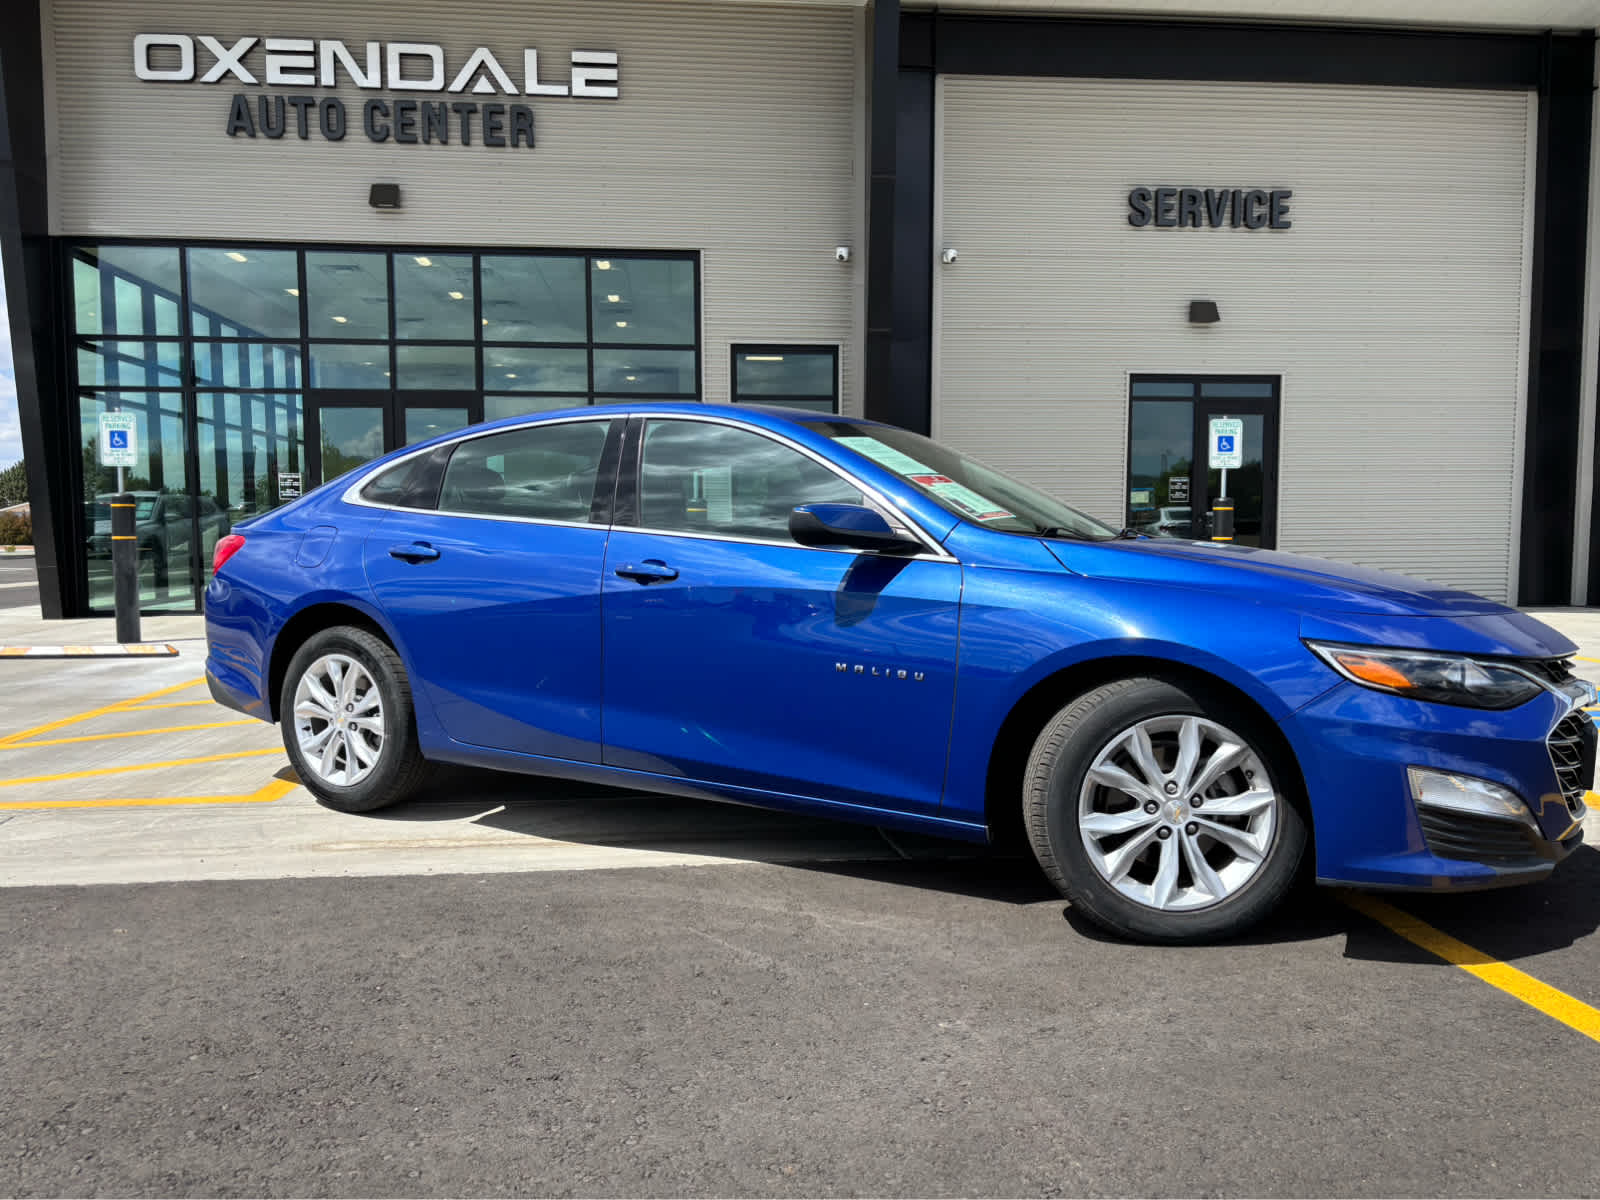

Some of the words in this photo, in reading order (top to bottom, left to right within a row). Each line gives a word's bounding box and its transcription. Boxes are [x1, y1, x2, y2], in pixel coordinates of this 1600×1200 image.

[134, 34, 619, 98] OXENDALE
[227, 94, 346, 141] AUTO
[363, 99, 536, 148] CENTER
[1127, 187, 1293, 230] SERVICE
[835, 662, 924, 681] MALIBU
